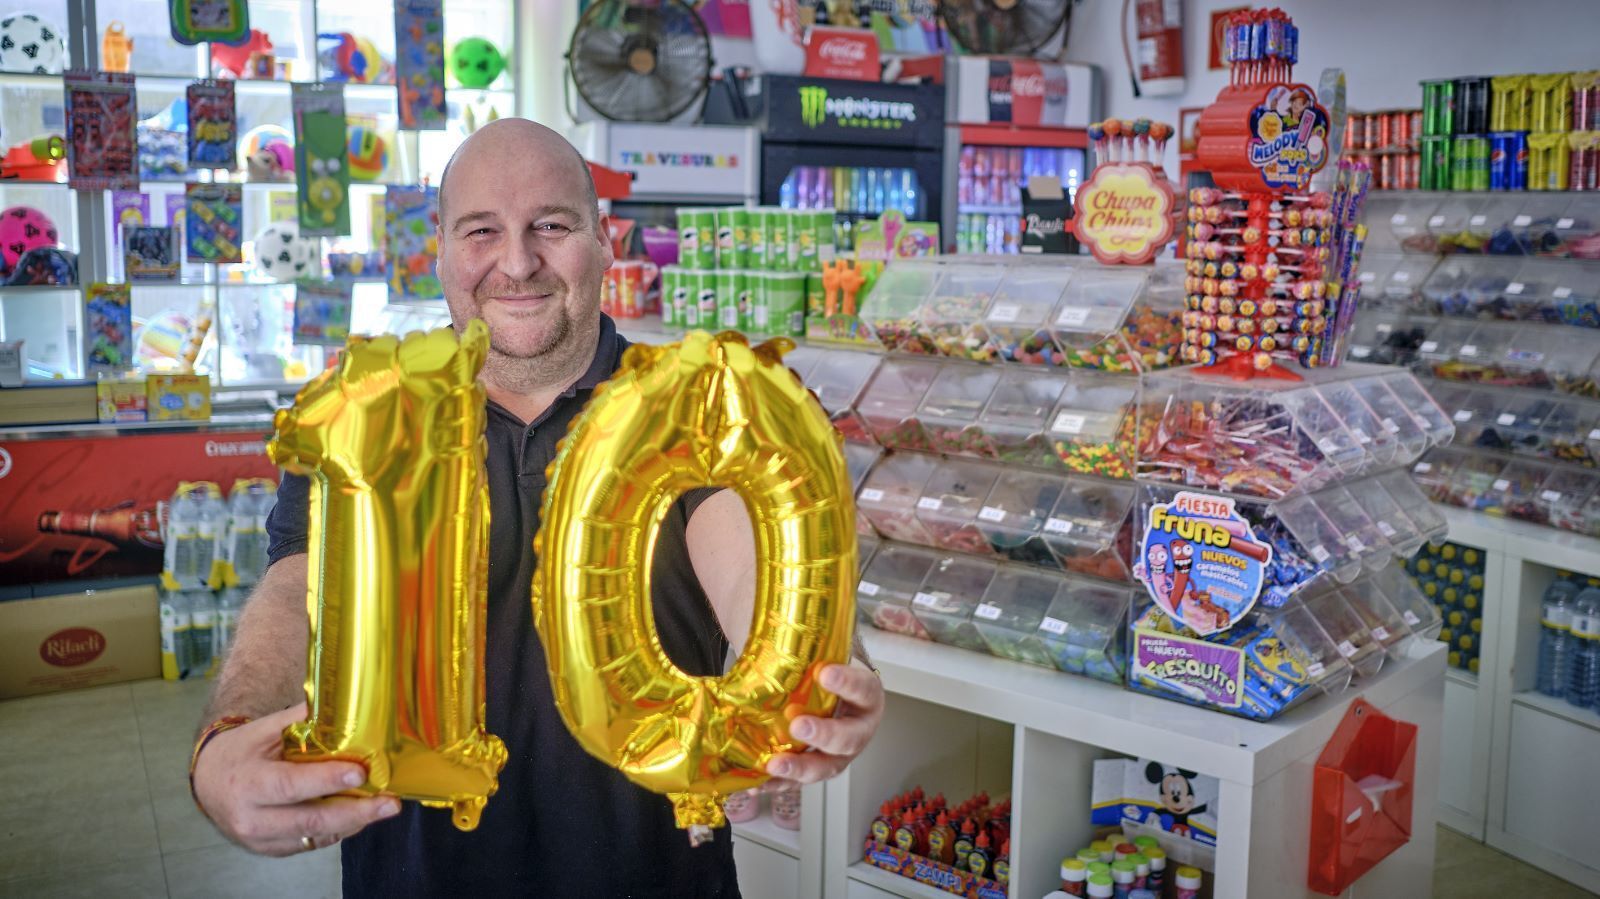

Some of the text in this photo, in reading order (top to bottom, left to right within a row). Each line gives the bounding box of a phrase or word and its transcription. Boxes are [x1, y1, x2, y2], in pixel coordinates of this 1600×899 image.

[826, 97, 916, 121] MONSTER
[1254, 131, 1299, 160] MELODY
[621, 151, 738, 168] TRAVESURAS
[1092, 190, 1157, 212] Chupa
[1088, 210, 1153, 231] Chups
[205, 440, 267, 457] Cruzcamp
[1177, 495, 1229, 517] FIESTA
[1202, 550, 1248, 571] NUEVOS
